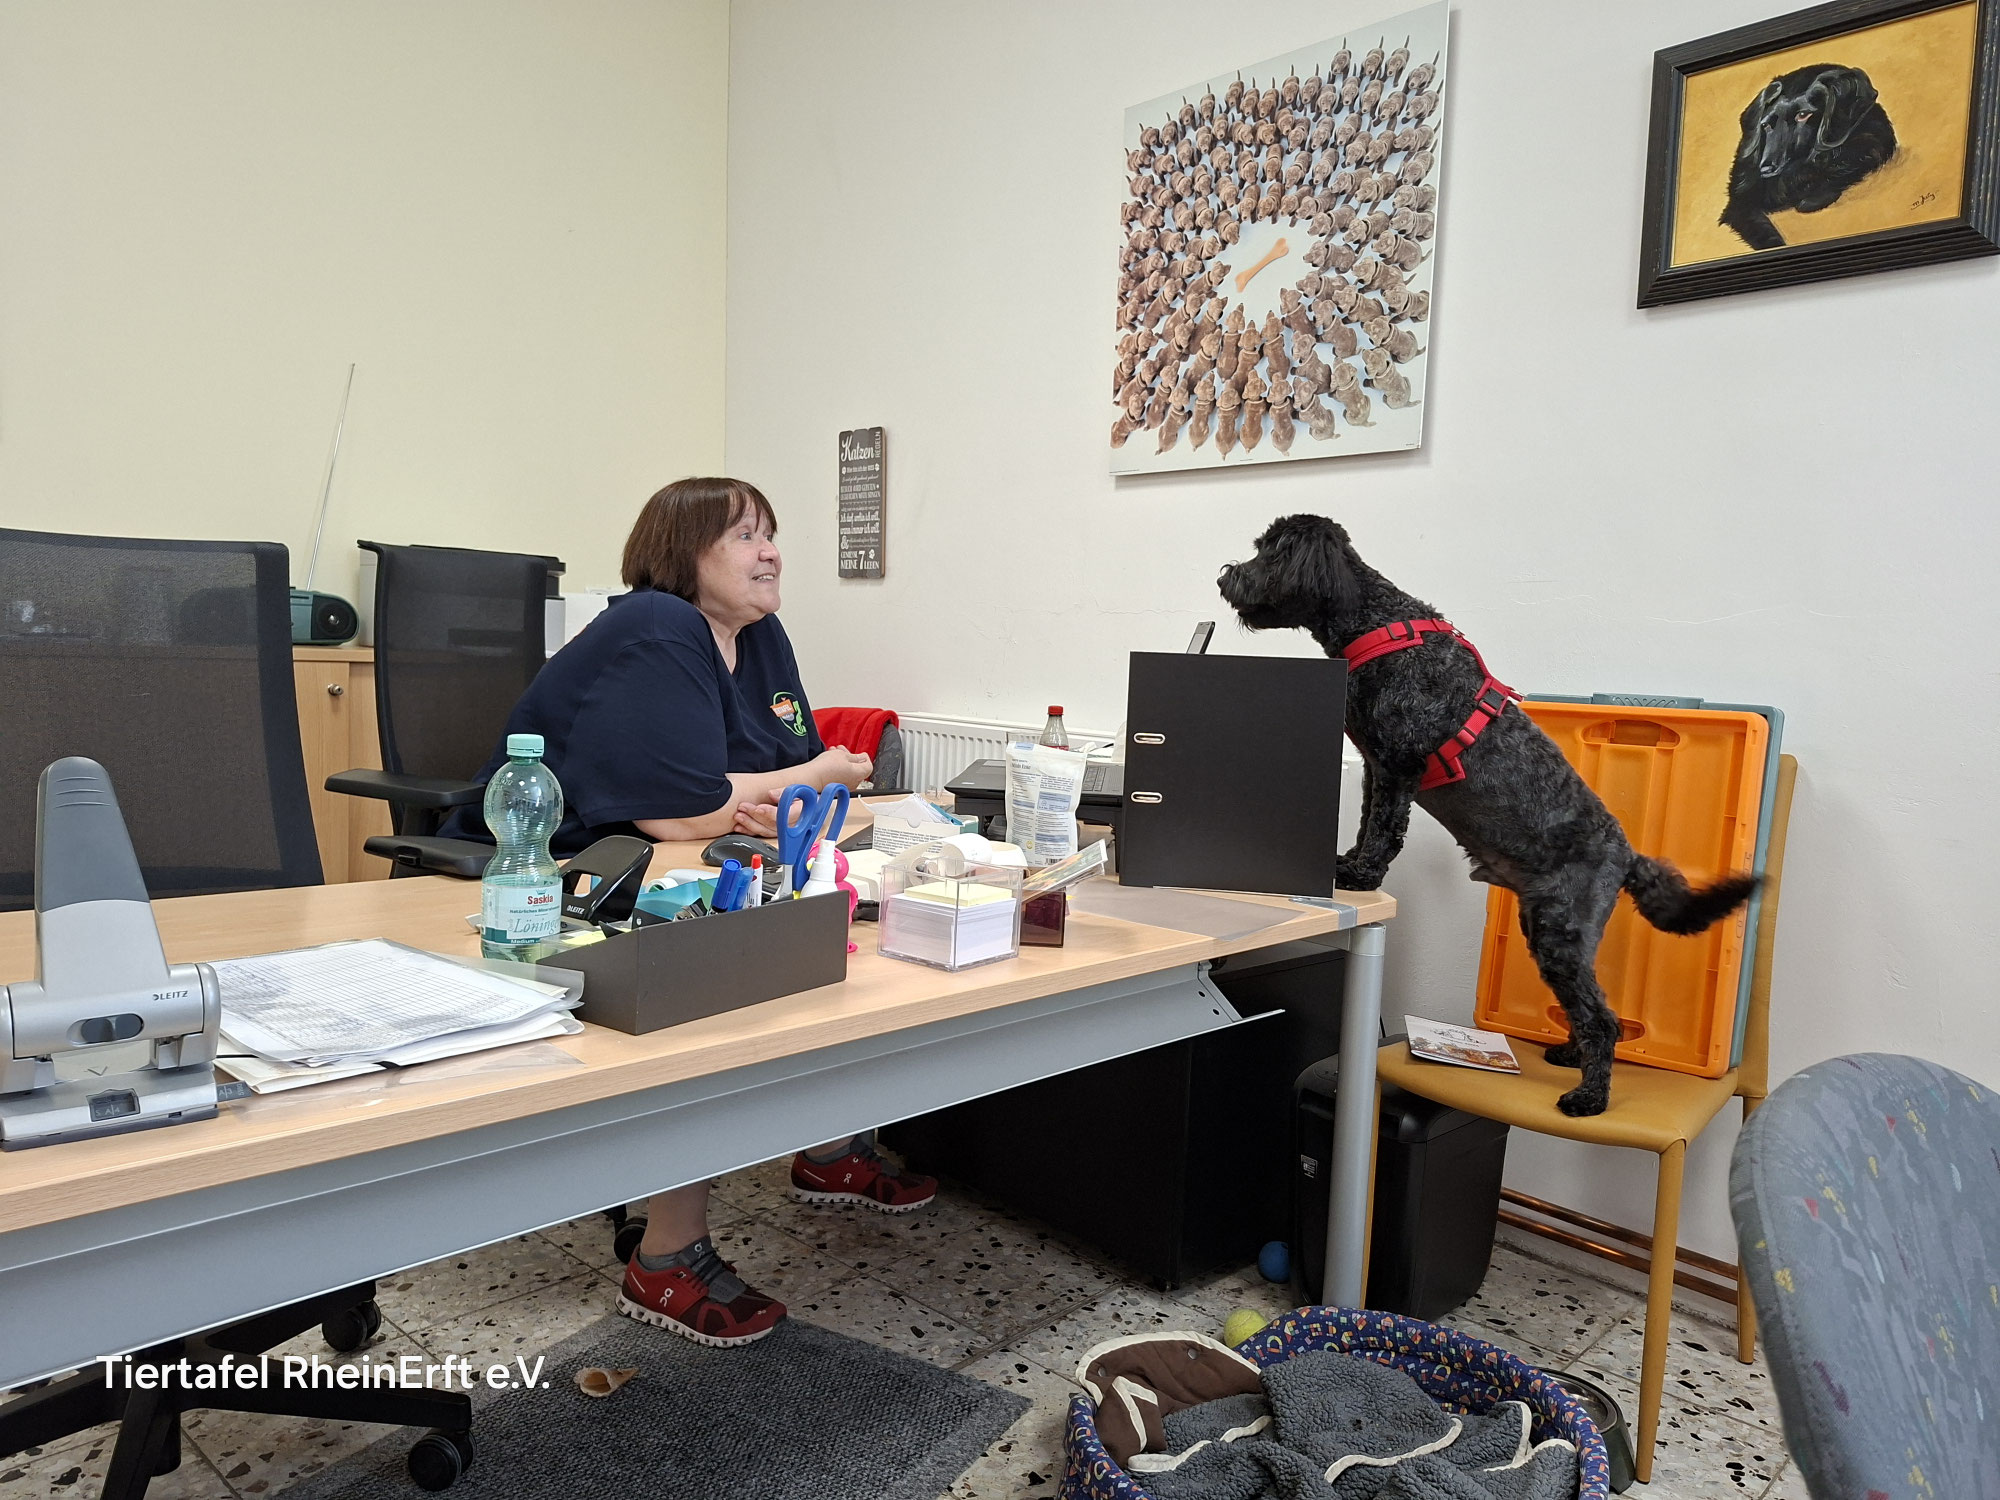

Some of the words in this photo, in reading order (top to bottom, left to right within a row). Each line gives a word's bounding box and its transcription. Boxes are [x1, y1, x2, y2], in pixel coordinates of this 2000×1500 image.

[840, 434, 874, 462] Katzen
[858, 550, 866, 570] 7
[527, 894, 554, 905] Saskia
[160, 990, 188, 1000] LEITZ
